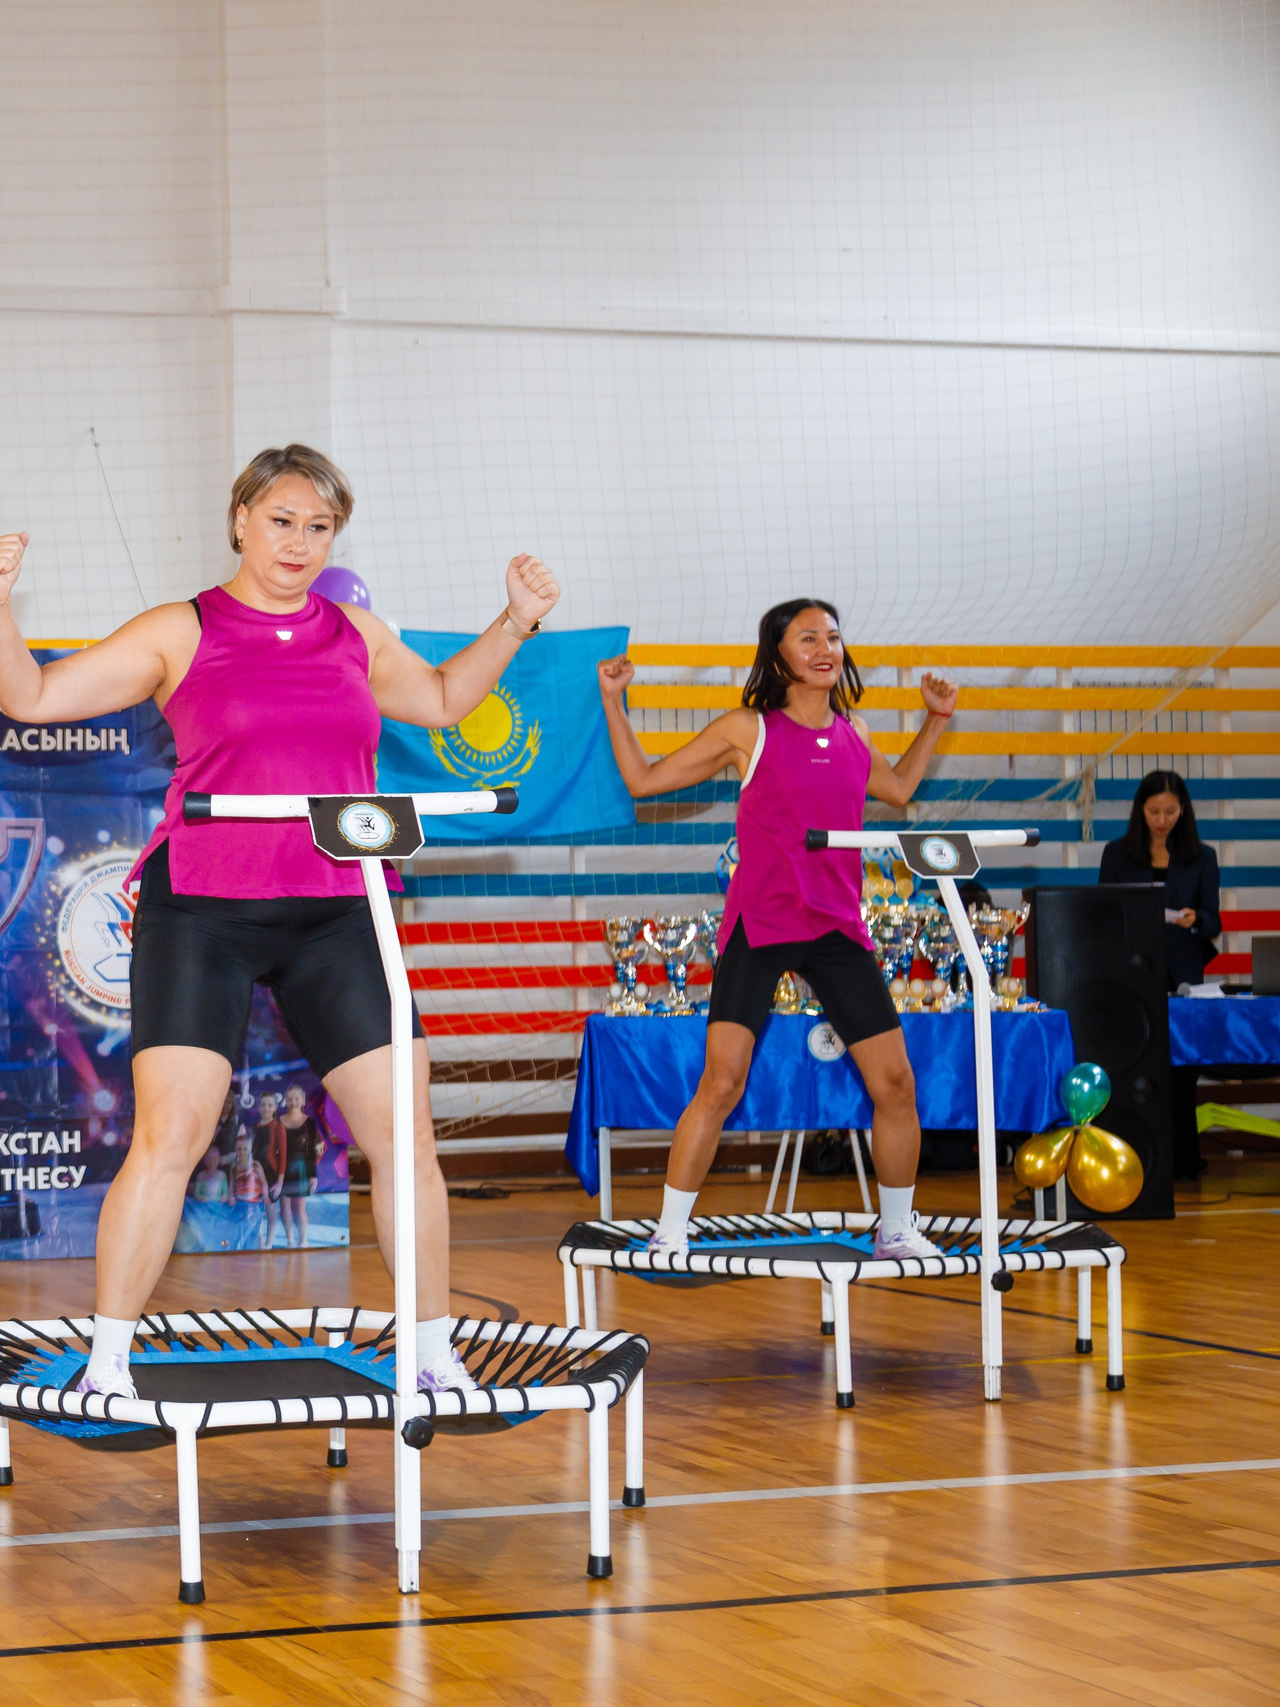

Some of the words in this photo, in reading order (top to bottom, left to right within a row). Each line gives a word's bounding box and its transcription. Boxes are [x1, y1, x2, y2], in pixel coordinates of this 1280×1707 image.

[61, 882, 90, 933] ФЕДЕРАЦИЯ
[63, 949, 87, 986] RUSSIAN
[86, 984, 122, 1005] JUMPING
